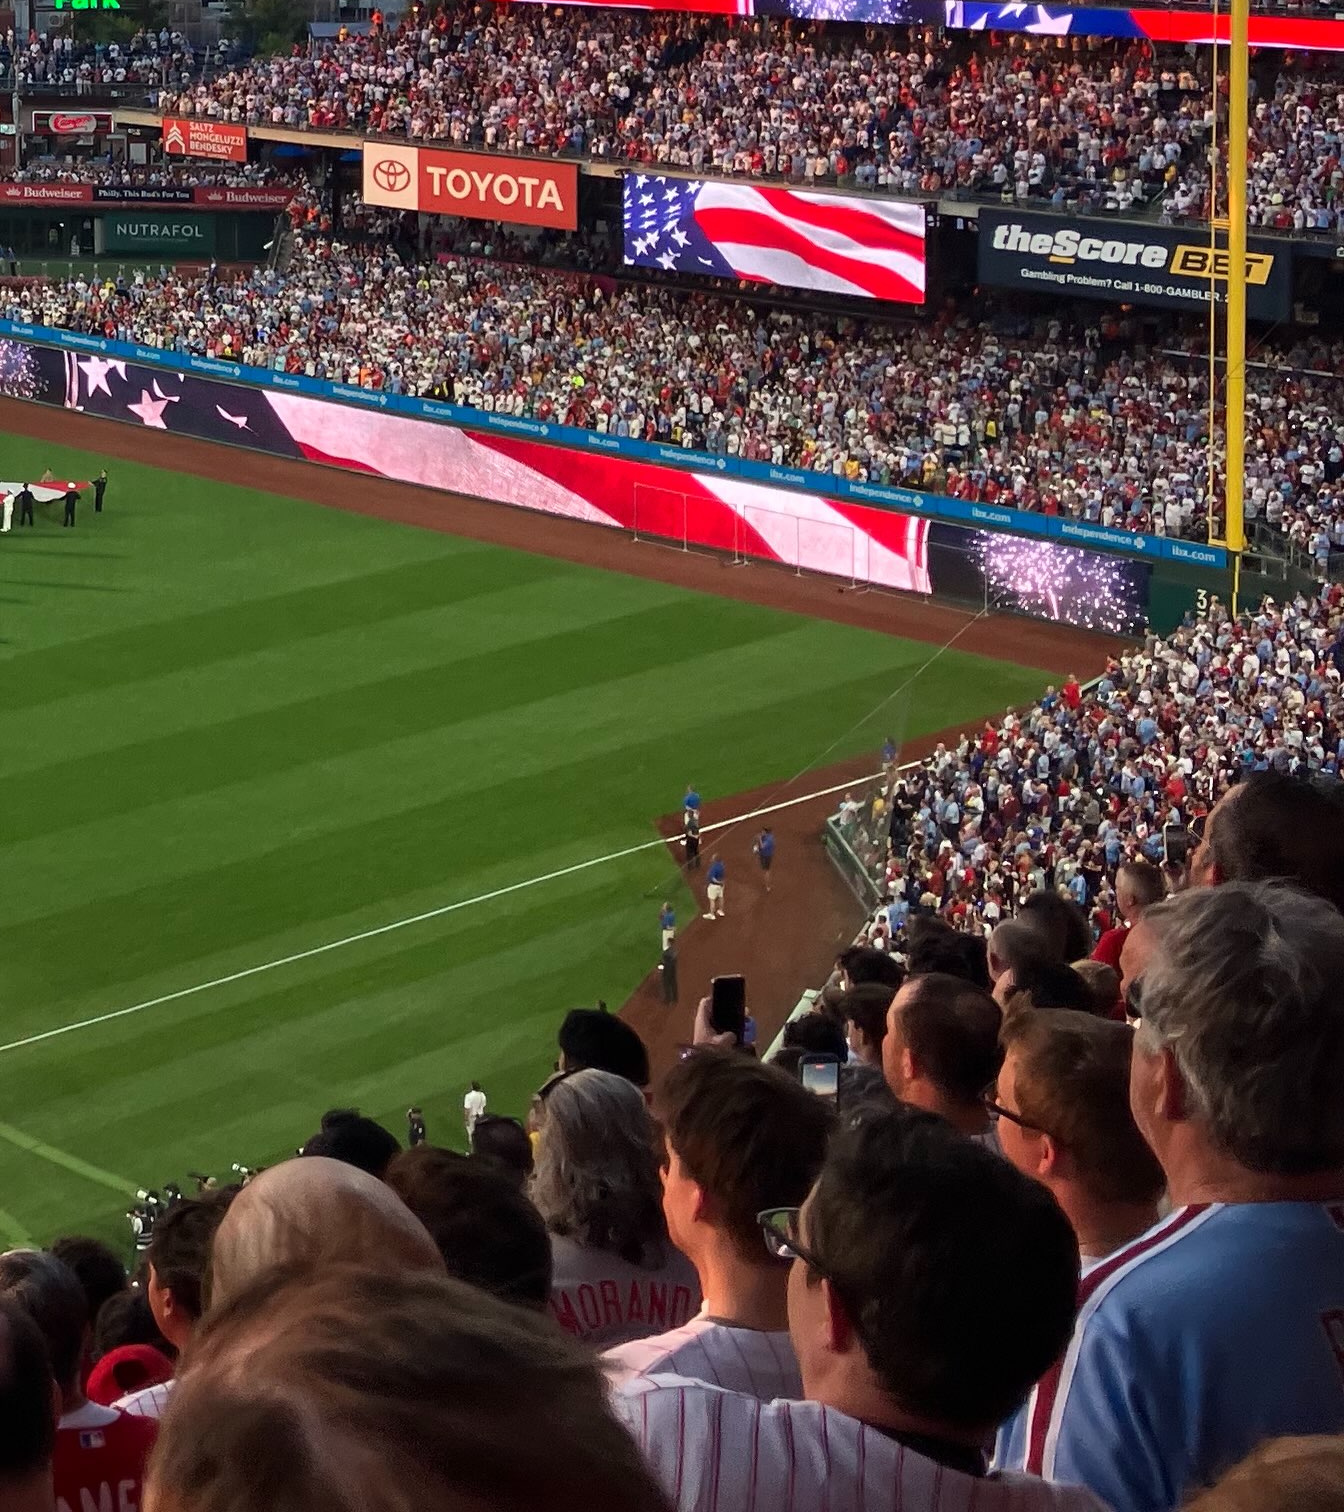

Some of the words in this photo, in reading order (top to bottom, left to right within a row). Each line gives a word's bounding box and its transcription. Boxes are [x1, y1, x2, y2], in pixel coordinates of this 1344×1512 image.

[189, 122, 214, 133] SALTZ
[189, 132, 245, 146] MONGELUZZI
[189, 141, 234, 155] BENDESKY
[23, 187, 83, 199] Budweiser
[123, 190, 140, 198] This
[176, 191, 190, 199] You
[426, 166, 564, 212] TOYOTA
[226, 192, 287, 204] Budweiser
[116, 223, 204, 238] NUTRAFOL
[992, 224, 1169, 268] theScore
[1020, 268, 1066, 284] Gambling
[1067, 273, 1113, 288] Problem?
[1113, 279, 1133, 291] Call
[769, 468, 806, 485] ibx.com
[849, 484, 912, 505] Independence
[971, 506, 1012, 523] ibx.com
[1061, 523, 1133, 547] Independence
[1171, 544, 1216, 563] ibx.com
